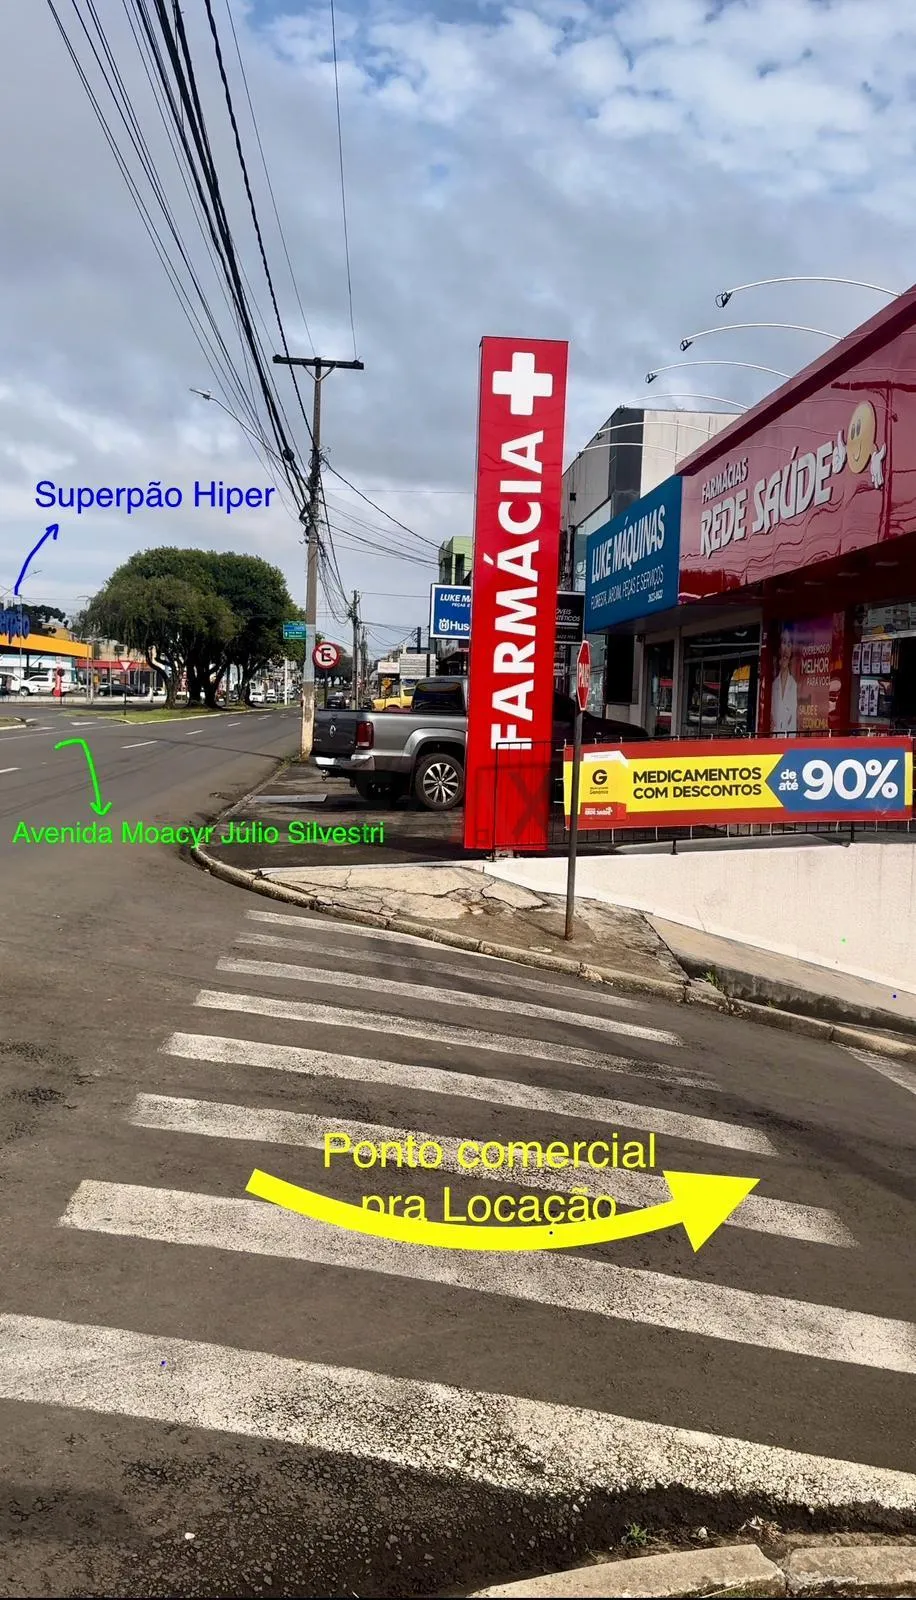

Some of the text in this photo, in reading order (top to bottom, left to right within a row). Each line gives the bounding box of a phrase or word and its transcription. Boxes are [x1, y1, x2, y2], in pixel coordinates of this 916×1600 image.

[702, 457, 748, 504] FARMÁCIAS
[700, 446, 833, 559] REDE SAÚDE
[591, 504, 666, 584] LUKE MÁQUINAS
[483, 430, 543, 750] FARMÁCIA
[622, 576, 636, 600] PEÇAS
[636, 575, 640, 593] E
[640, 564, 664, 591] SERVIÇOS
[440, 593, 461, 602] LUKE
[801, 658, 829, 674] MELHOR
[592, 769, 608, 785] G
[633, 767, 762, 784] MEDICAMENTOS
[780, 768, 797, 780] de
[802, 758, 899, 800] 90%
[633, 783, 762, 800] COM DESCONTOS
[778, 779, 799, 791] até
